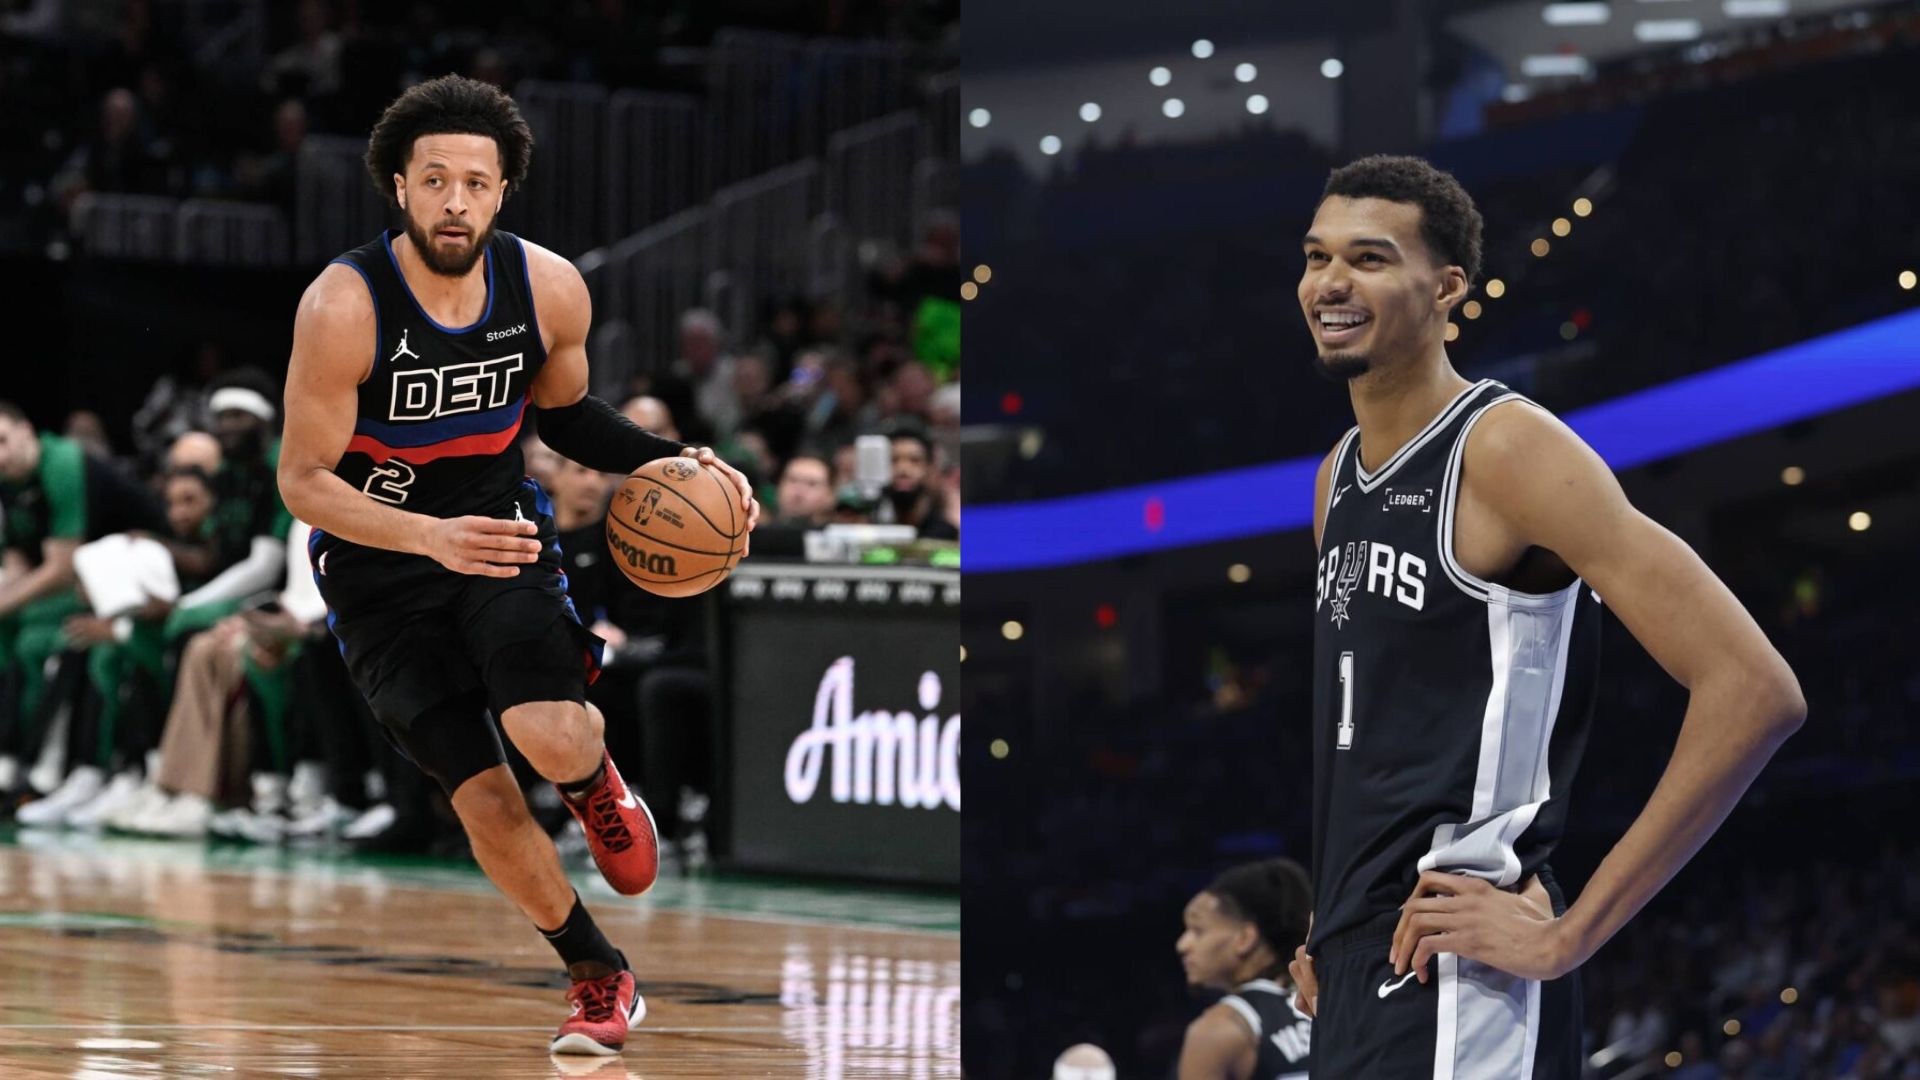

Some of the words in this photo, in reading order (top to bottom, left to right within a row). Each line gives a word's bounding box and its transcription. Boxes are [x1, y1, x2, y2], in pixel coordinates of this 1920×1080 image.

[486, 323, 528, 342] StockX
[389, 352, 523, 421] DET
[363, 458, 416, 505] 2
[1389, 494, 1426, 506] LEDGER
[1316, 540, 1427, 631] SPURS
[1336, 650, 1354, 750] 1
